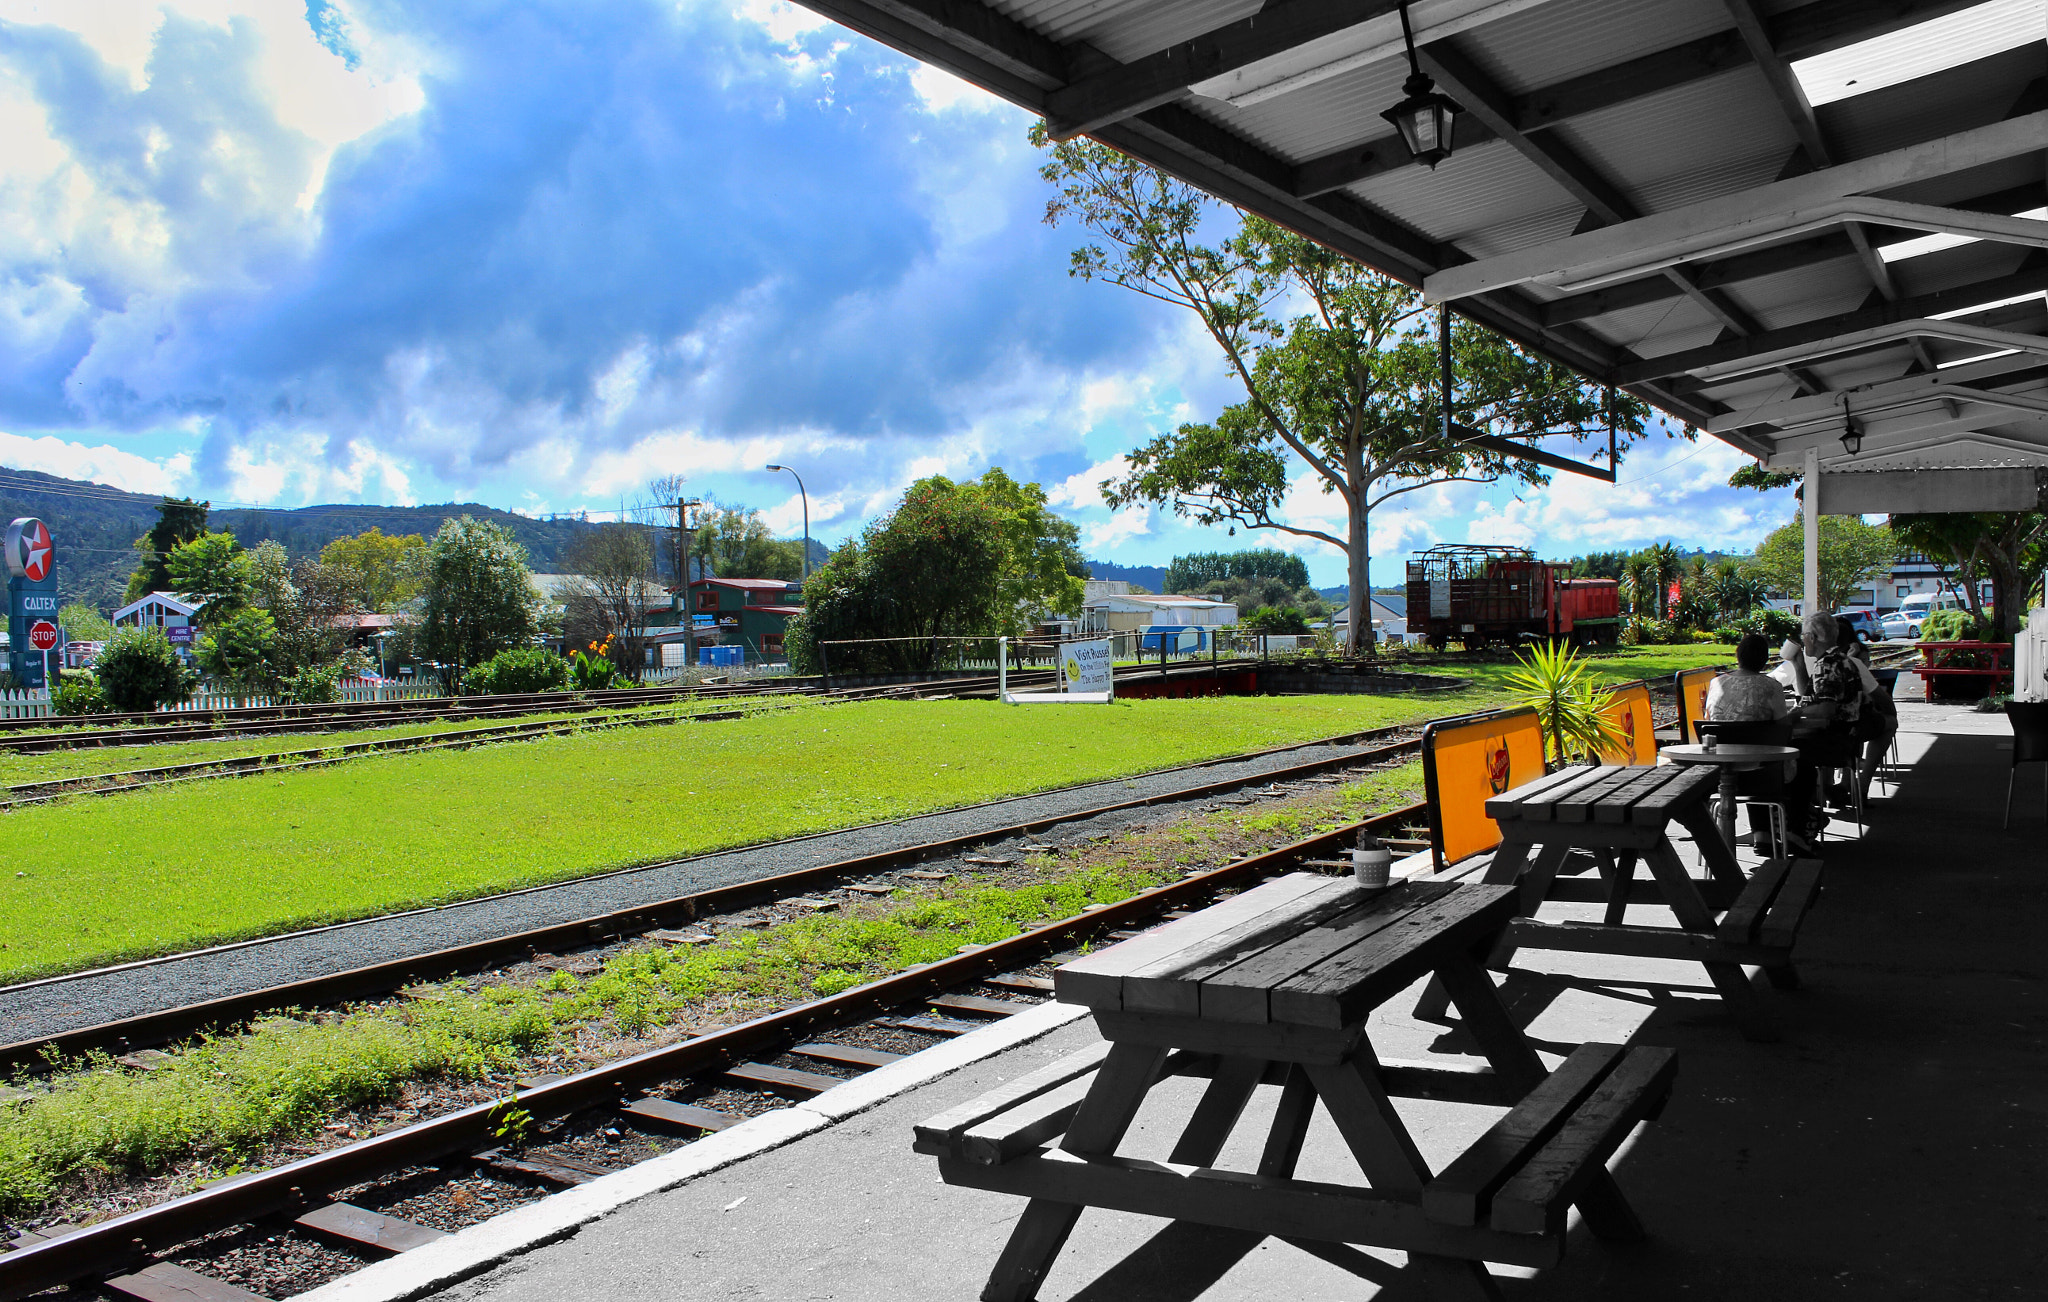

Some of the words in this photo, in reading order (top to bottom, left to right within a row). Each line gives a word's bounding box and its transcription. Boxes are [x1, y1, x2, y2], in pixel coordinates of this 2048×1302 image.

[24, 597, 56, 611] CALTEX
[33, 631, 55, 641] STOP
[1075, 649, 1092, 661] Visit
